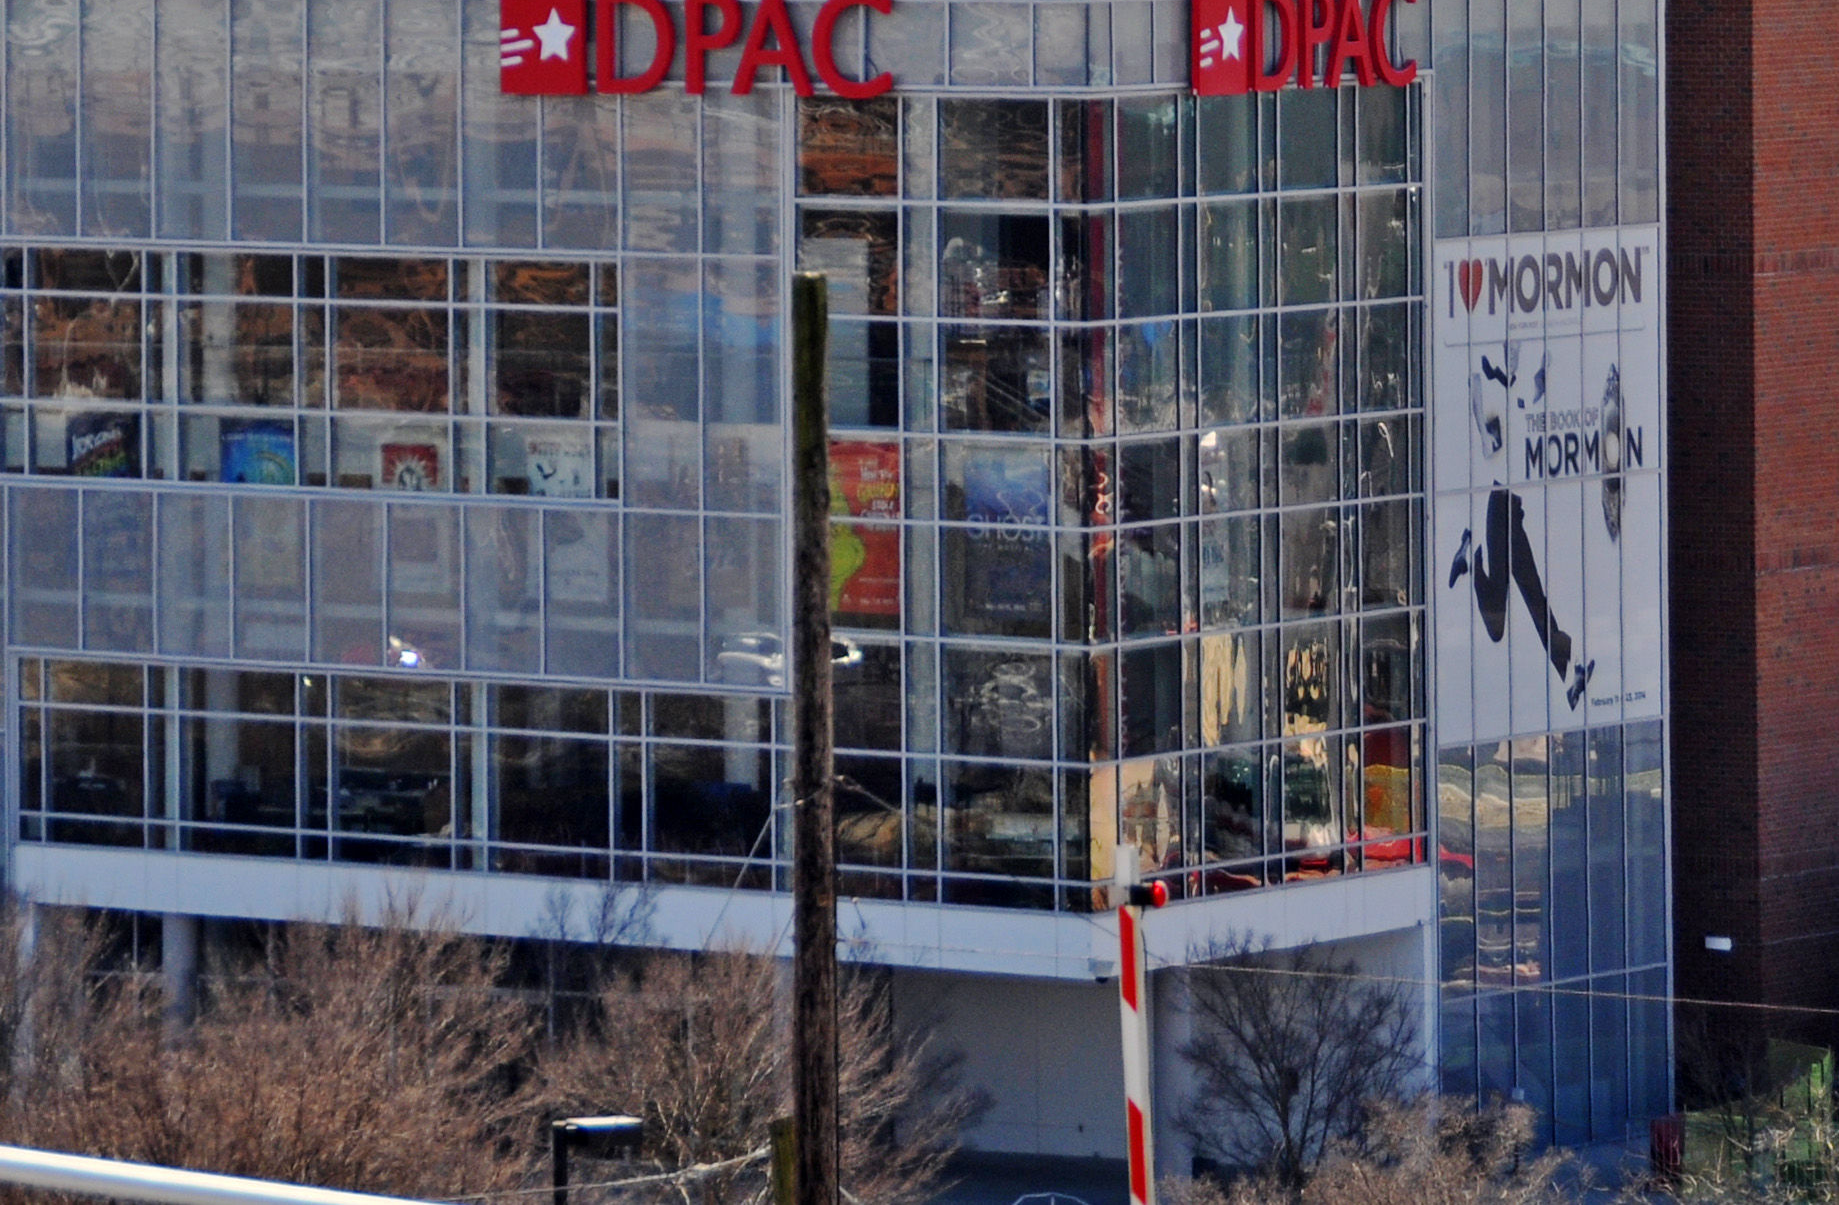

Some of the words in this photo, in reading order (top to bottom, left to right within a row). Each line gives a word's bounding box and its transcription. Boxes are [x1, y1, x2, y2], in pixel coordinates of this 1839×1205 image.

[1525, 413, 1547, 433] THE
[1549, 409, 1581, 431] BOOK
[1584, 407, 1600, 427] OF
